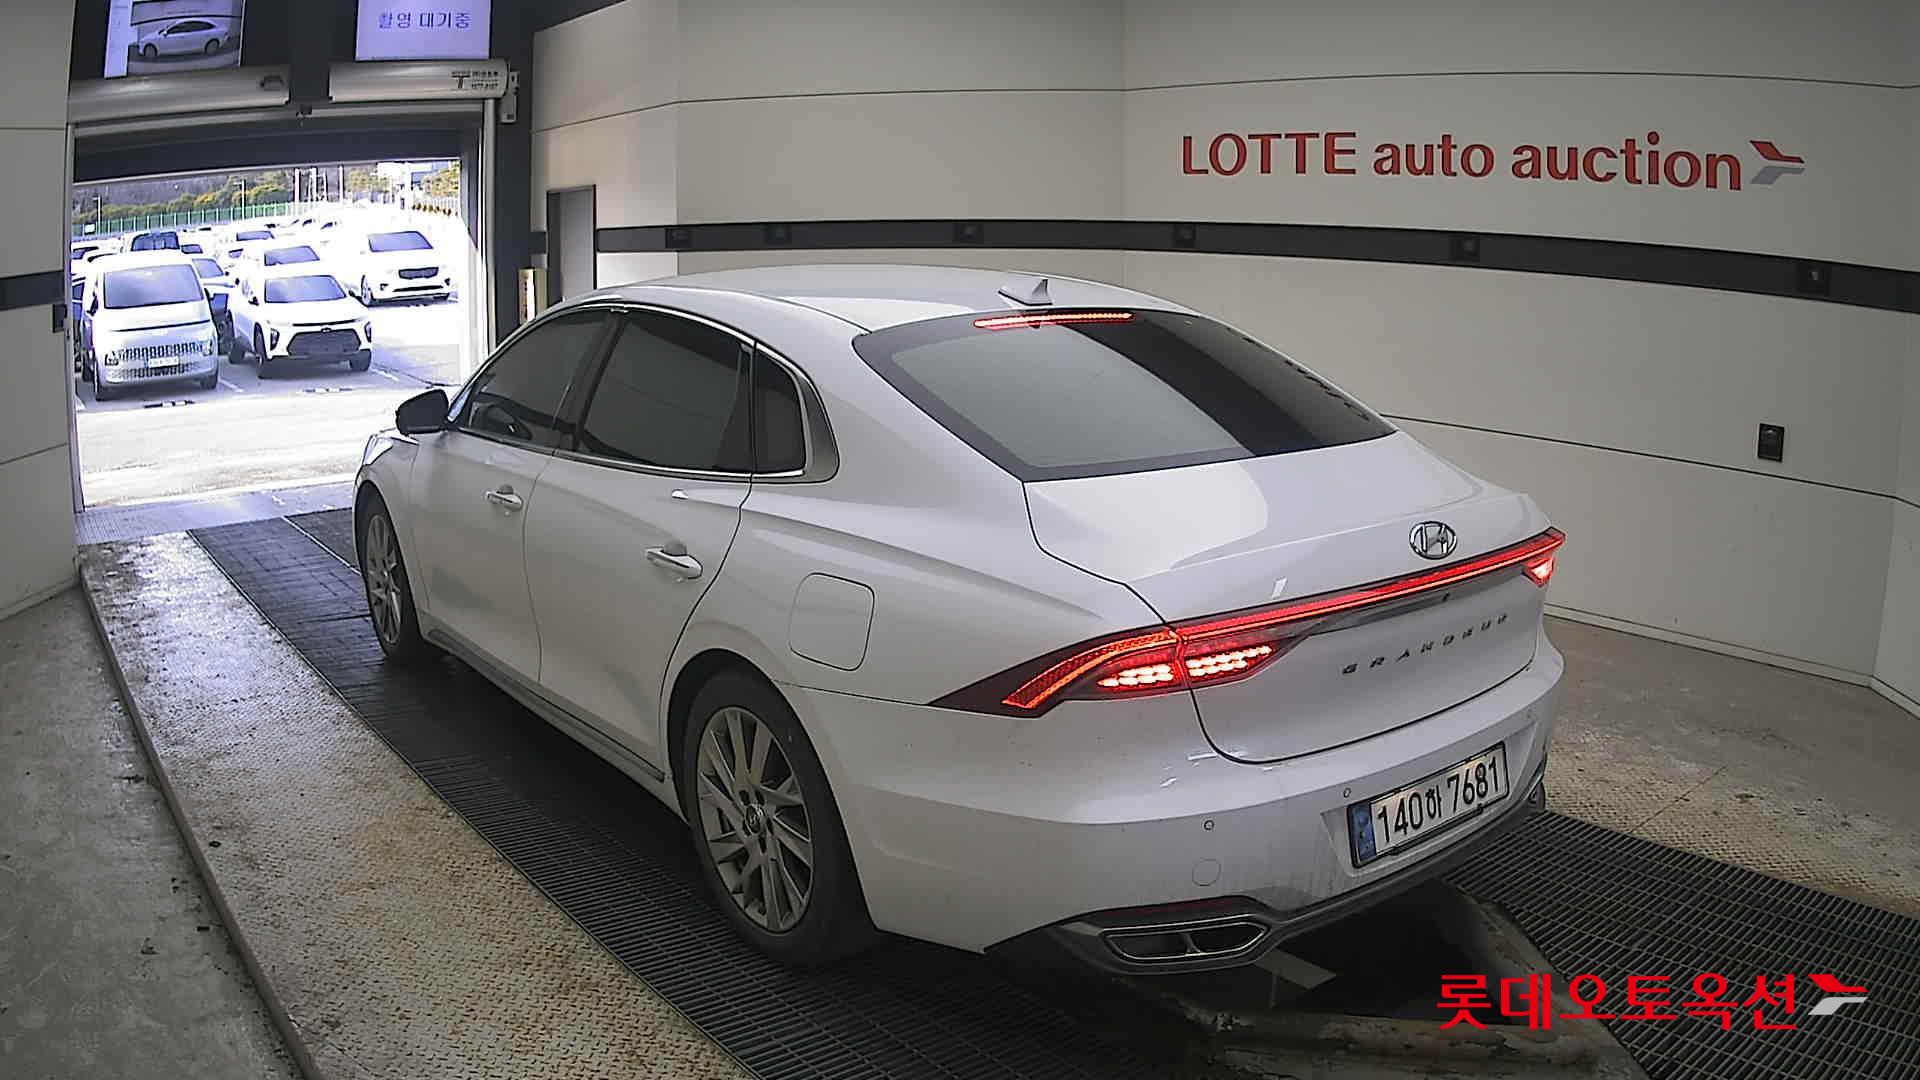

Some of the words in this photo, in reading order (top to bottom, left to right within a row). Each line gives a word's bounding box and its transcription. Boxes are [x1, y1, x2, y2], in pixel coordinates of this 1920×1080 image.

[419, 11, 473, 29] 대기중
[1181, 131, 1357, 176] LOTTE
[1373, 134, 1495, 178] auto
[1511, 131, 1742, 191] auction
[1342, 613, 1507, 675] GRANDEUR
[1377, 784, 1442, 843] 140하
[1447, 756, 1499, 813] 7681
